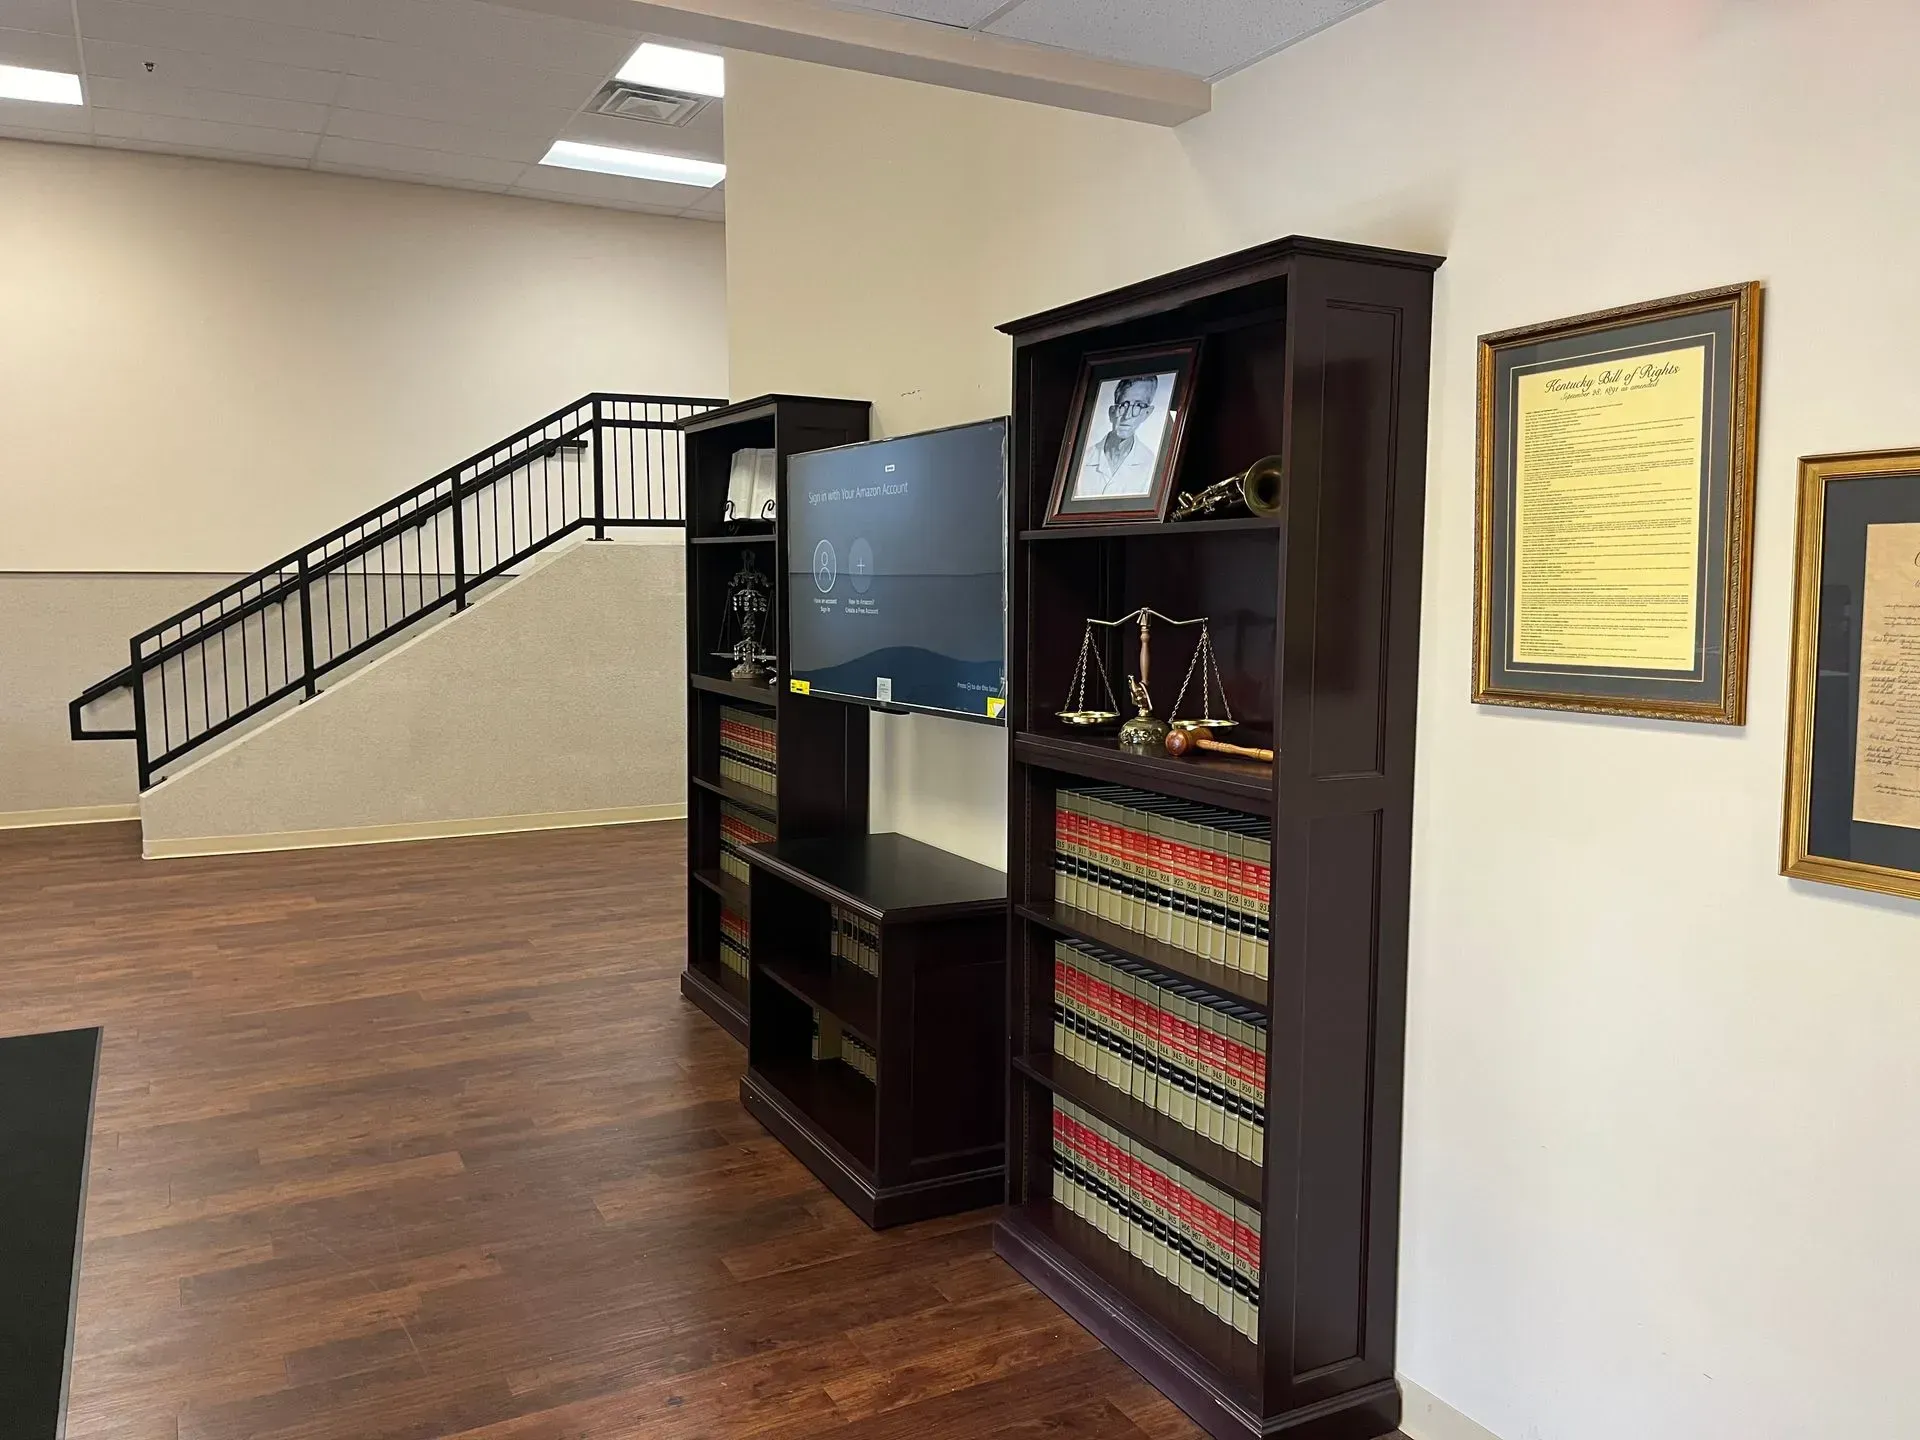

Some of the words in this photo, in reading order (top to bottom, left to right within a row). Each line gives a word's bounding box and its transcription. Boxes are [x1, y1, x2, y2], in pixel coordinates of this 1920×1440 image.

[1544, 374, 1593, 393] Kentucky
[1598, 369, 1623, 385] Bill
[1624, 366, 1641, 385] of
[1640, 361, 1680, 382] Rights
[1630, 382, 1658, 391] amended
[808, 492, 820, 506] Sign
[821, 491, 828, 502] in
[828, 488, 841, 501] with
[841, 488, 855, 501] Your
[856, 485, 881, 499] Amazon
[882, 482, 909, 496] Account
[1200, 885, 1210, 894] 927
[1213, 889, 1224, 898] 928
[1228, 894, 1239, 903] 929
[1243, 899, 1255, 908] 930
